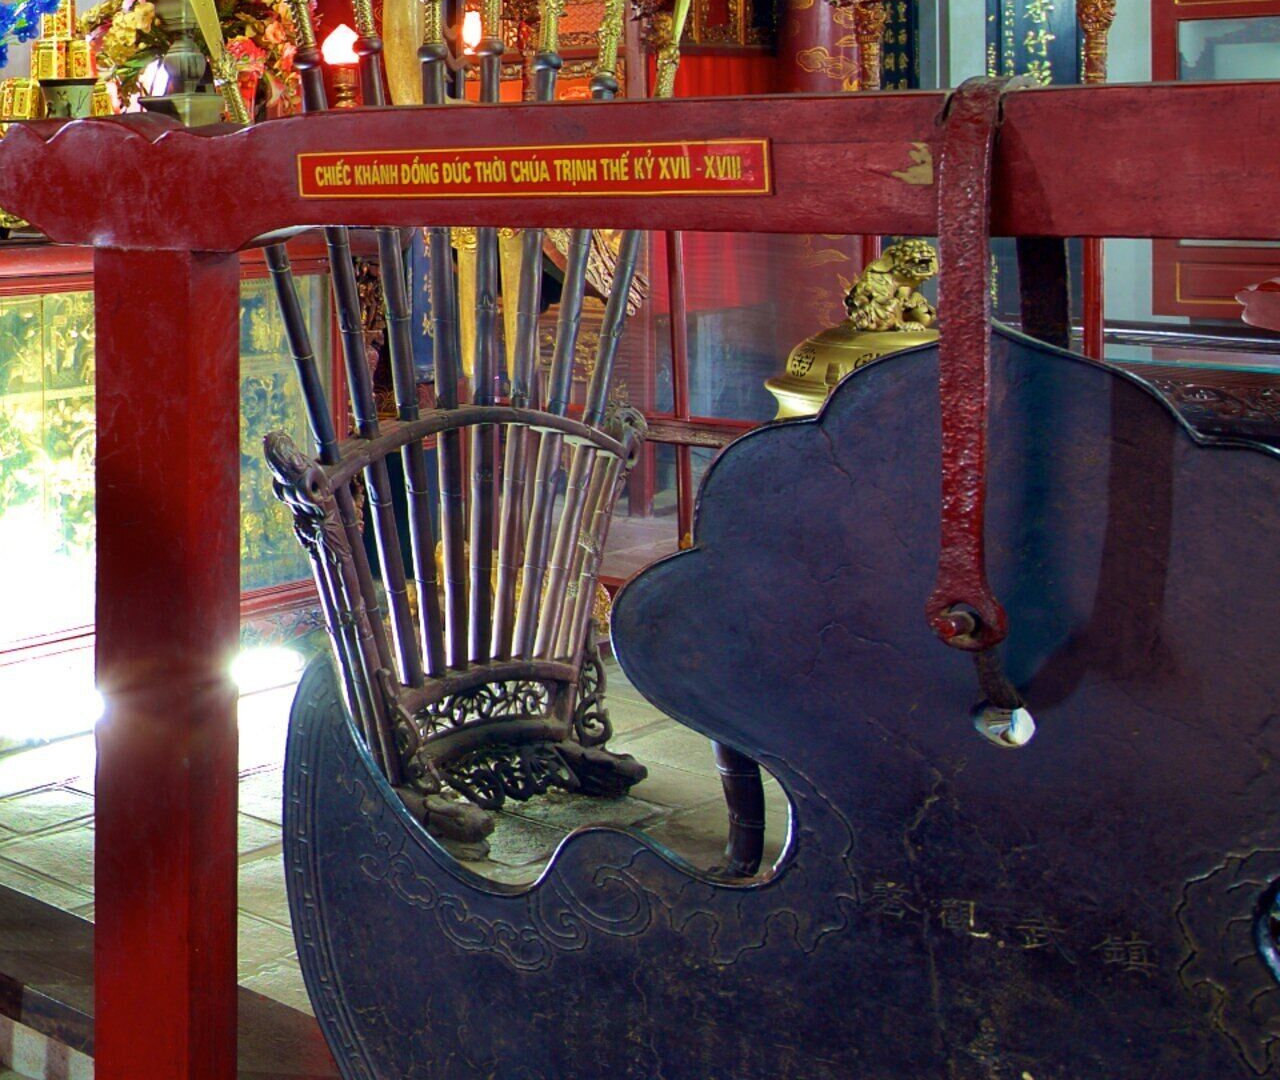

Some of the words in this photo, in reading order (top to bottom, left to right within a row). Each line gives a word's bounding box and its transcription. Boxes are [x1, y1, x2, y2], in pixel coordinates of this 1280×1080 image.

[315, 158, 351, 186] CHIẾC
[354, 160, 399, 186] KHÁNH
[400, 155, 439, 185] ĐỒNG
[442, 156, 471, 184] ĐÚC
[474, 155, 507, 183] THỜI
[510, 154, 551, 183] CHÚA
[553, 159, 598, 187] TRỊNH
[600, 150, 629, 182] THẾ
[633, 148, 655, 180] KỶ
[658, 155, 691, 180] XVII
[703, 154, 741, 180] XVIII
